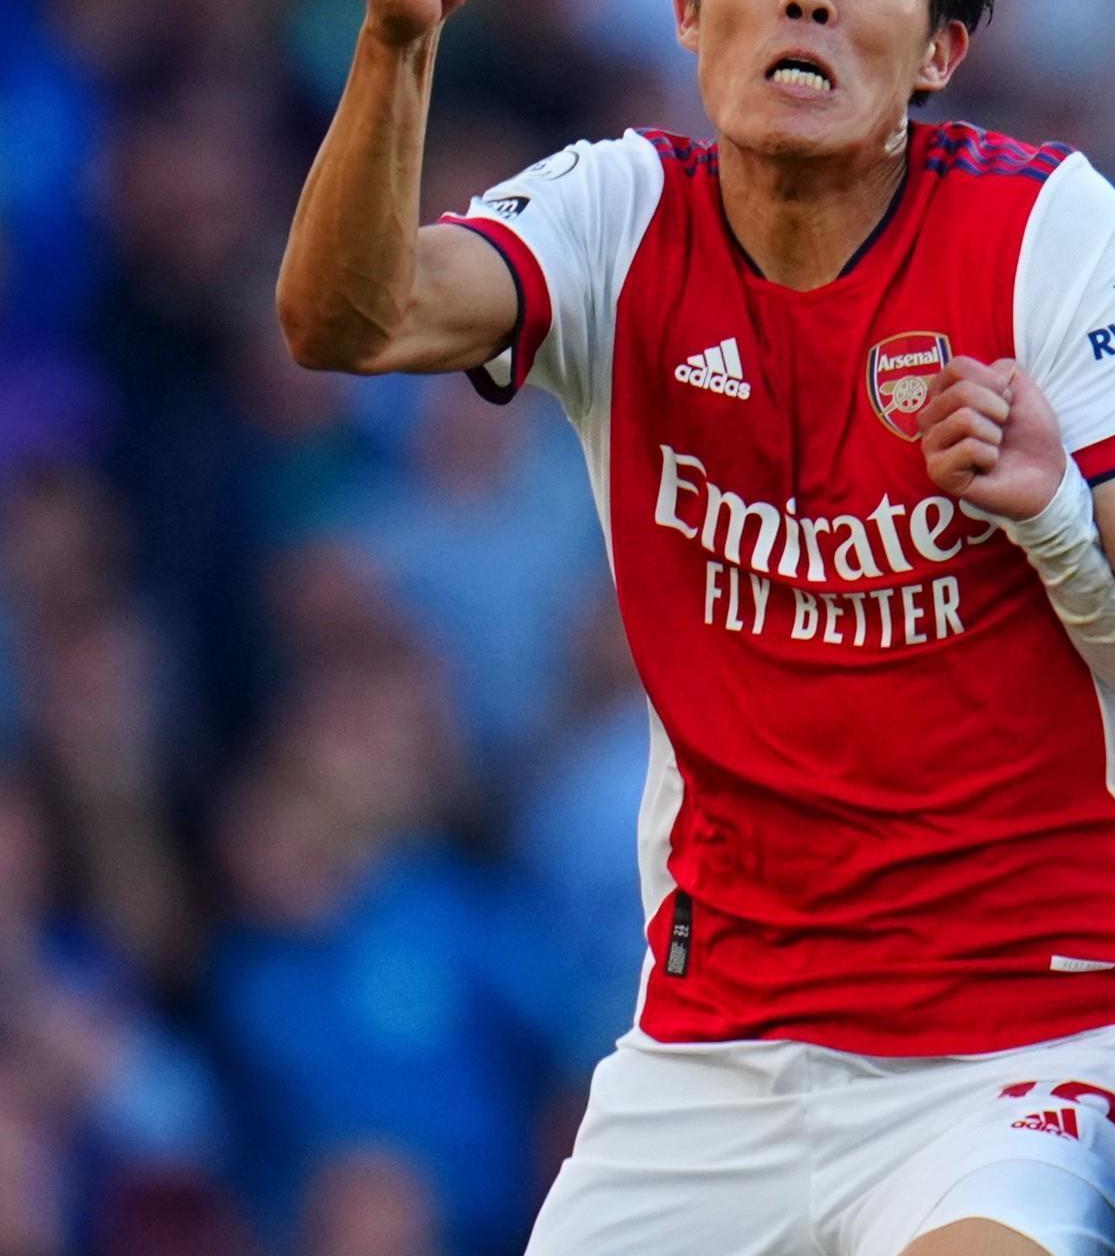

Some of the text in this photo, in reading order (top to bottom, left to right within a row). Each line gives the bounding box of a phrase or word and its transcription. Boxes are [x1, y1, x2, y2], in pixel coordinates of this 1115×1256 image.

[878, 346, 940, 373] Arsenal
[674, 363, 751, 400] adidas
[704, 560, 965, 648] FLY BETTER
